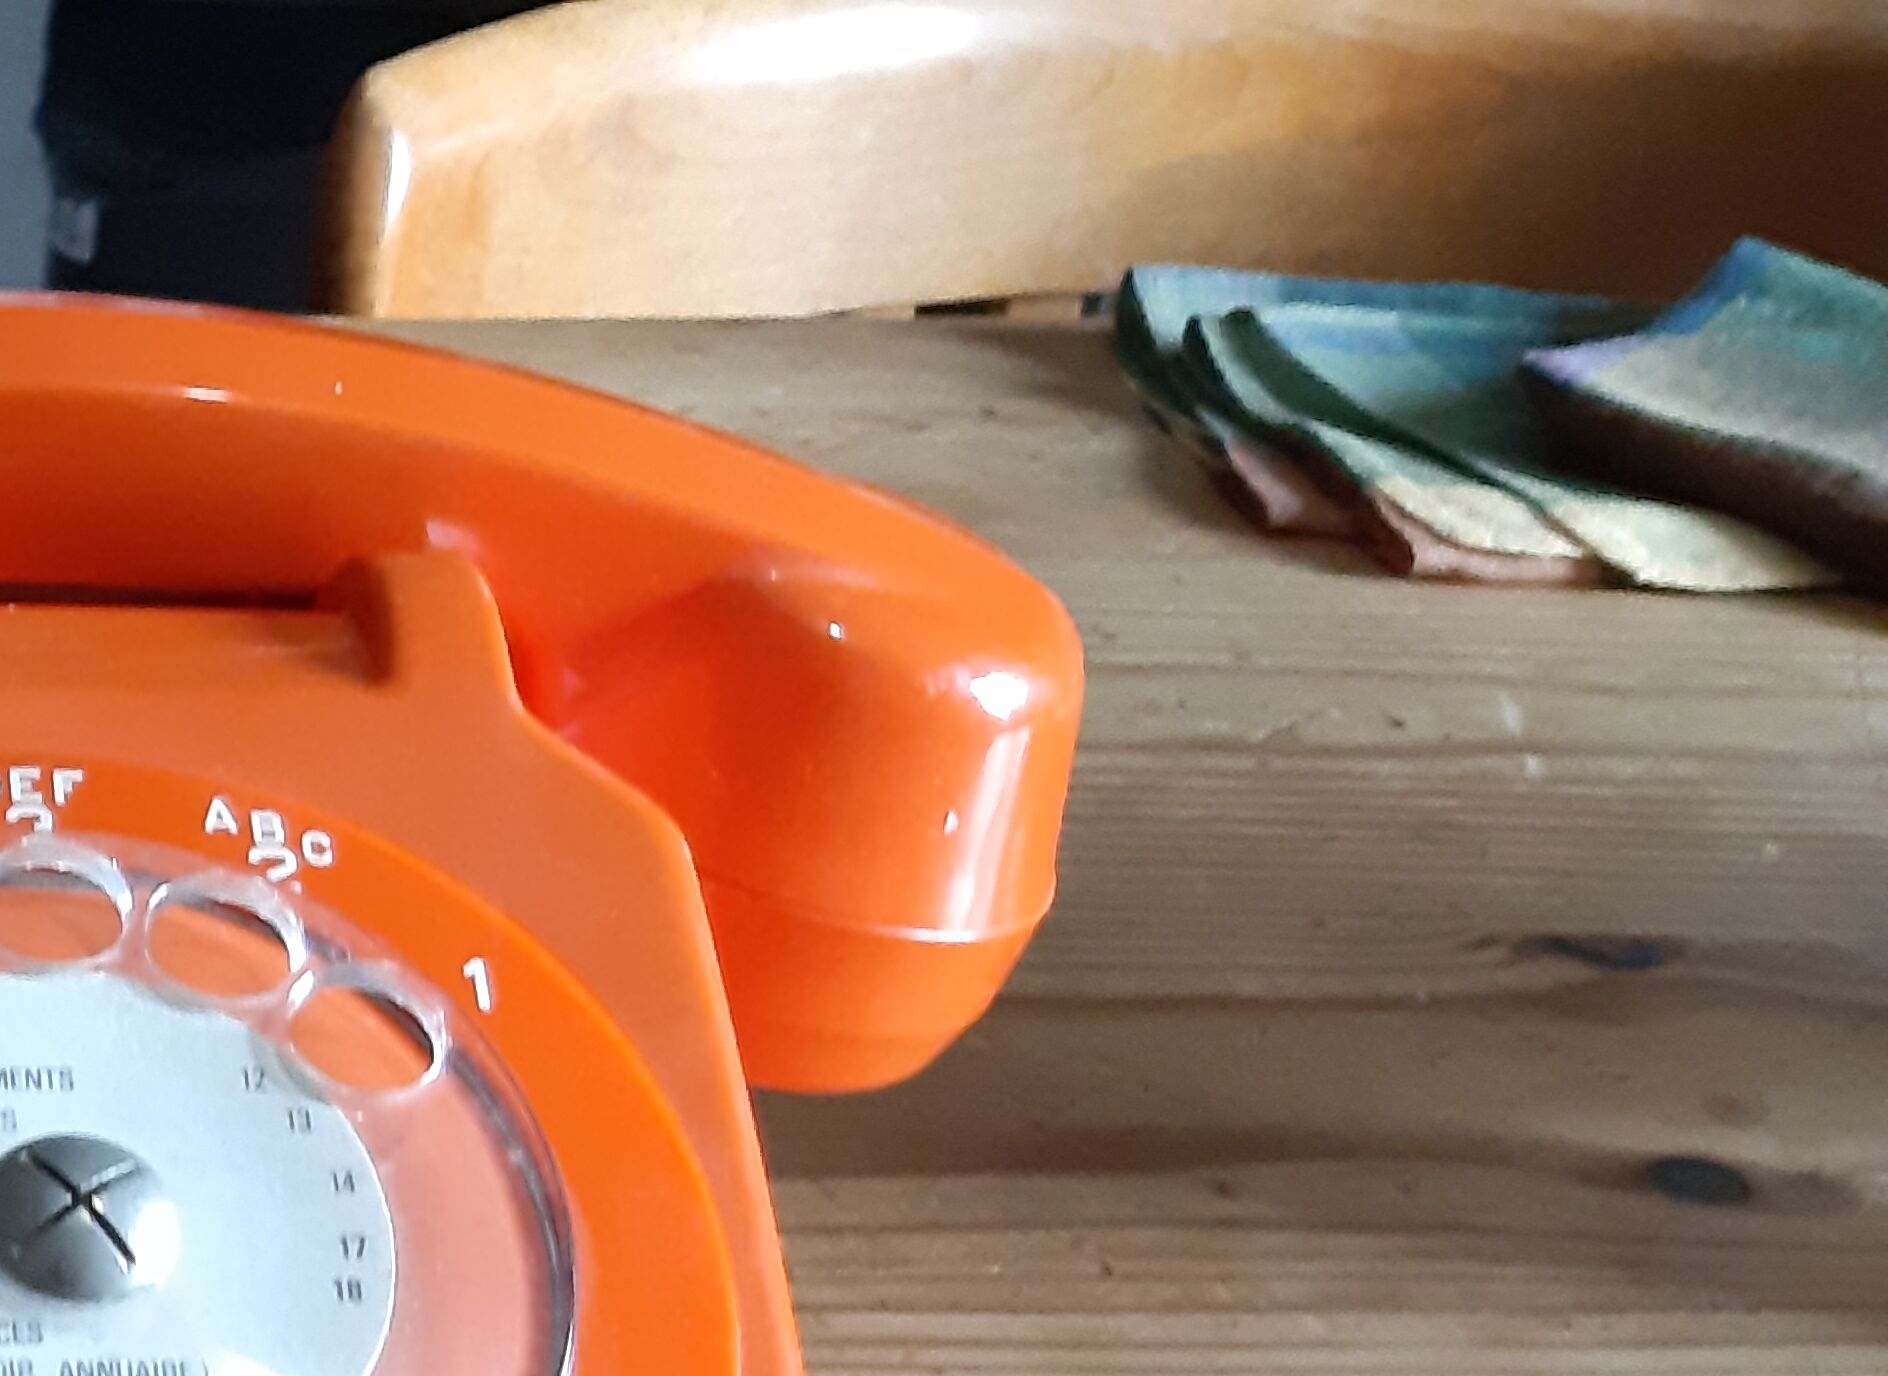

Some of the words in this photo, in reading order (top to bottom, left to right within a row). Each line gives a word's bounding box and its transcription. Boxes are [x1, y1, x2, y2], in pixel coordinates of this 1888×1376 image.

[205, 796, 333, 868] ABC
[464, 957, 495, 1013] 1
[242, 1067, 265, 1091] 12
[288, 1108, 312, 1133] 13
[332, 1170, 356, 1193] 14
[341, 1235, 366, 1259] 17
[334, 1278, 363, 1302] 18
